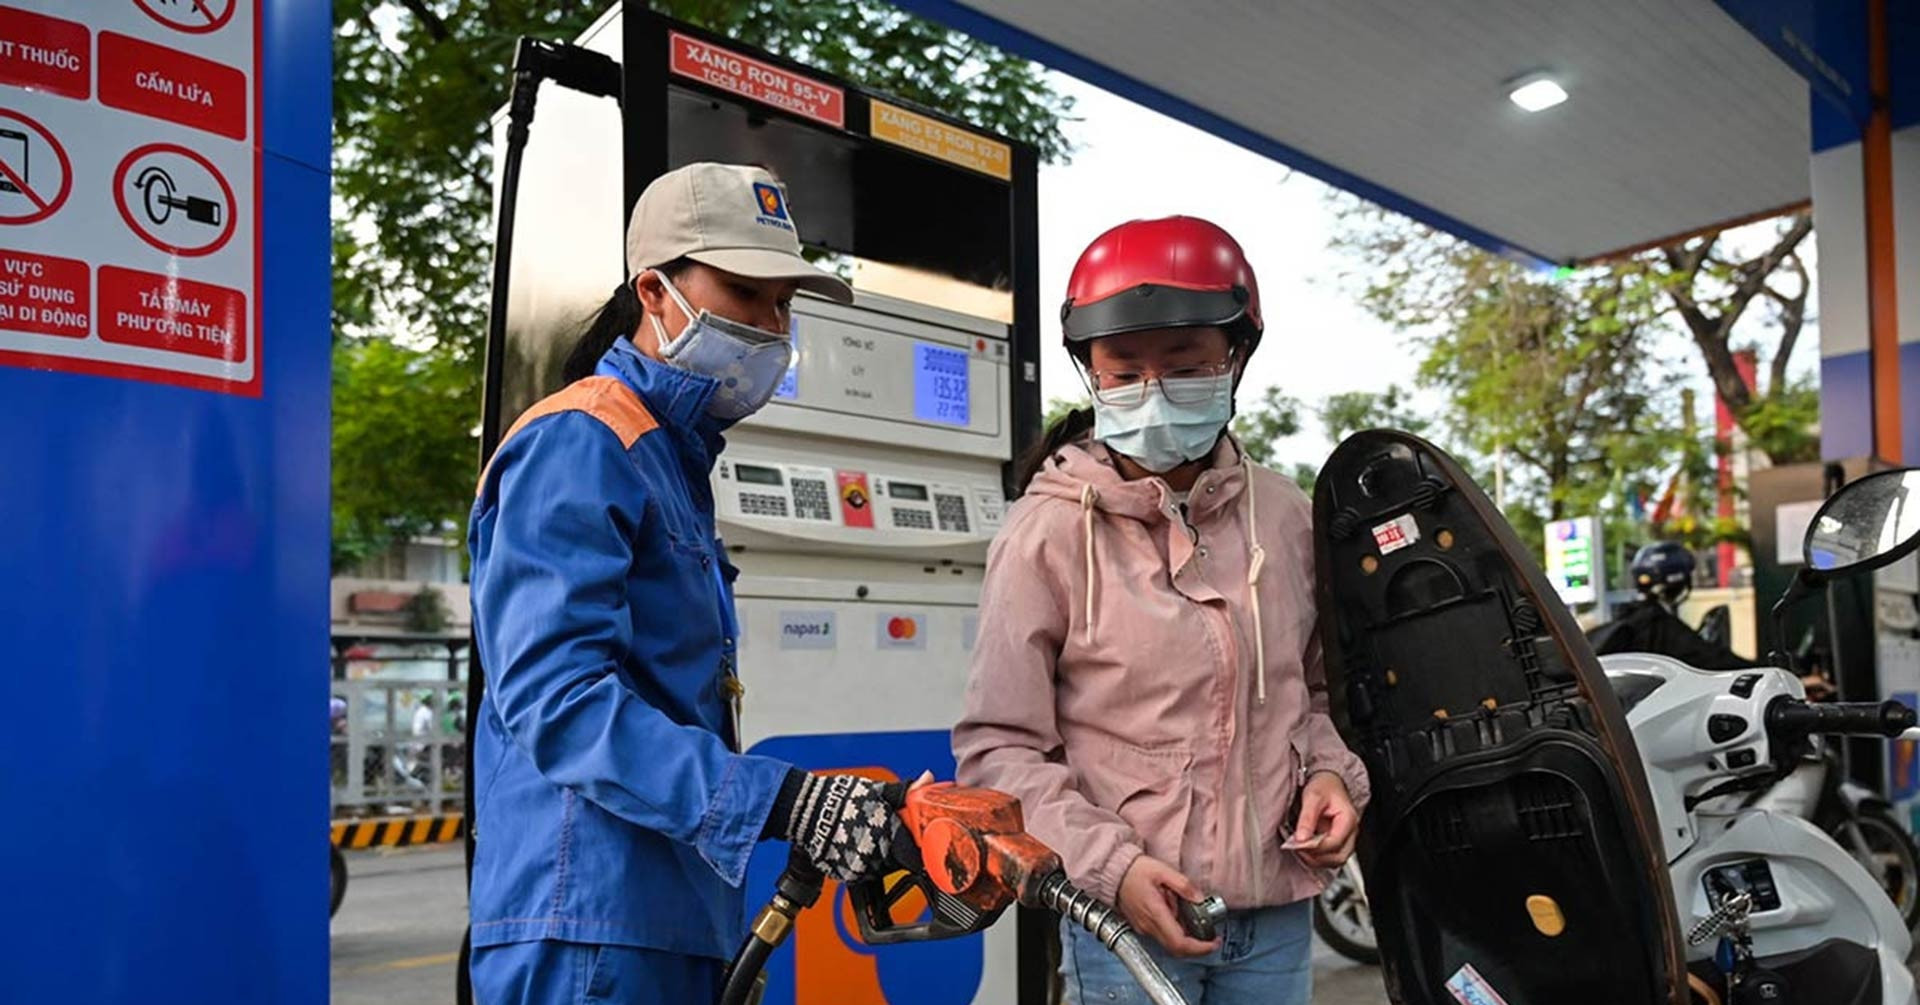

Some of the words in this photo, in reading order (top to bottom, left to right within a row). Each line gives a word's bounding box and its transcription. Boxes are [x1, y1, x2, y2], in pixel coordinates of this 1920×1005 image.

[0, 40, 15, 57] T
[19, 43, 80, 73] THUỐC
[135, 71, 173, 95] CẤM
[178, 83, 214, 107] LỬA
[702, 67, 737, 90] TCCS
[748, 65, 788, 92] RON
[793, 81, 830, 106] 95-V
[4, 258, 43, 278] VỰC
[28, 284, 75, 305] DỤNG
[19, 306, 36, 322] DI
[41, 306, 88, 329] ĐỘNG
[178, 298, 211, 318] MÁY
[116, 311, 193, 338] PHƯƠNG
[196, 323, 231, 346] TIỆN
[783, 624, 820, 639] napas
